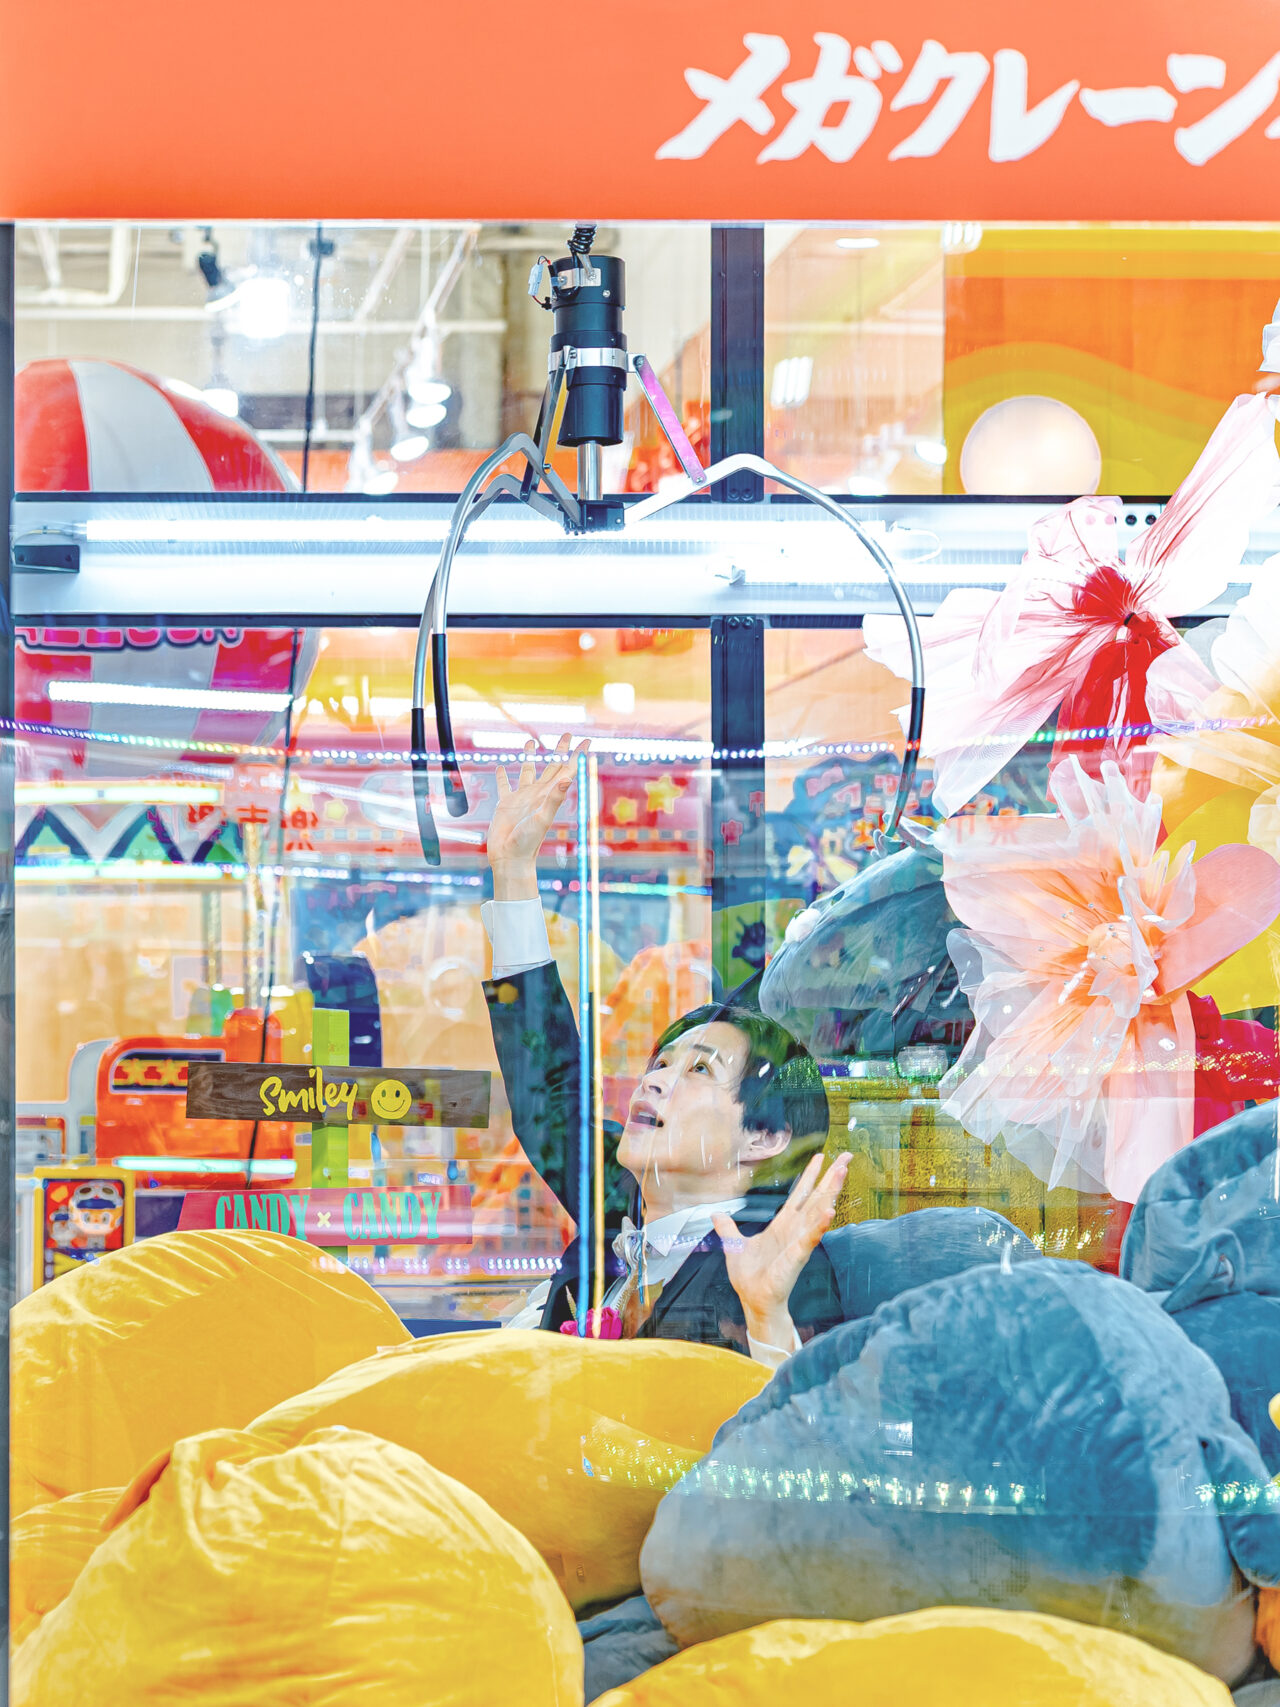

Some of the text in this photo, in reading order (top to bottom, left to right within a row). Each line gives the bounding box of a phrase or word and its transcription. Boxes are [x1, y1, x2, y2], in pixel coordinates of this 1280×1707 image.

[655, 32, 1280, 166] メガクレーン
[260, 1066, 358, 1120] Smiley
[215, 1193, 310, 1241] CANDY
[343, 1192, 442, 1240] CANDY
